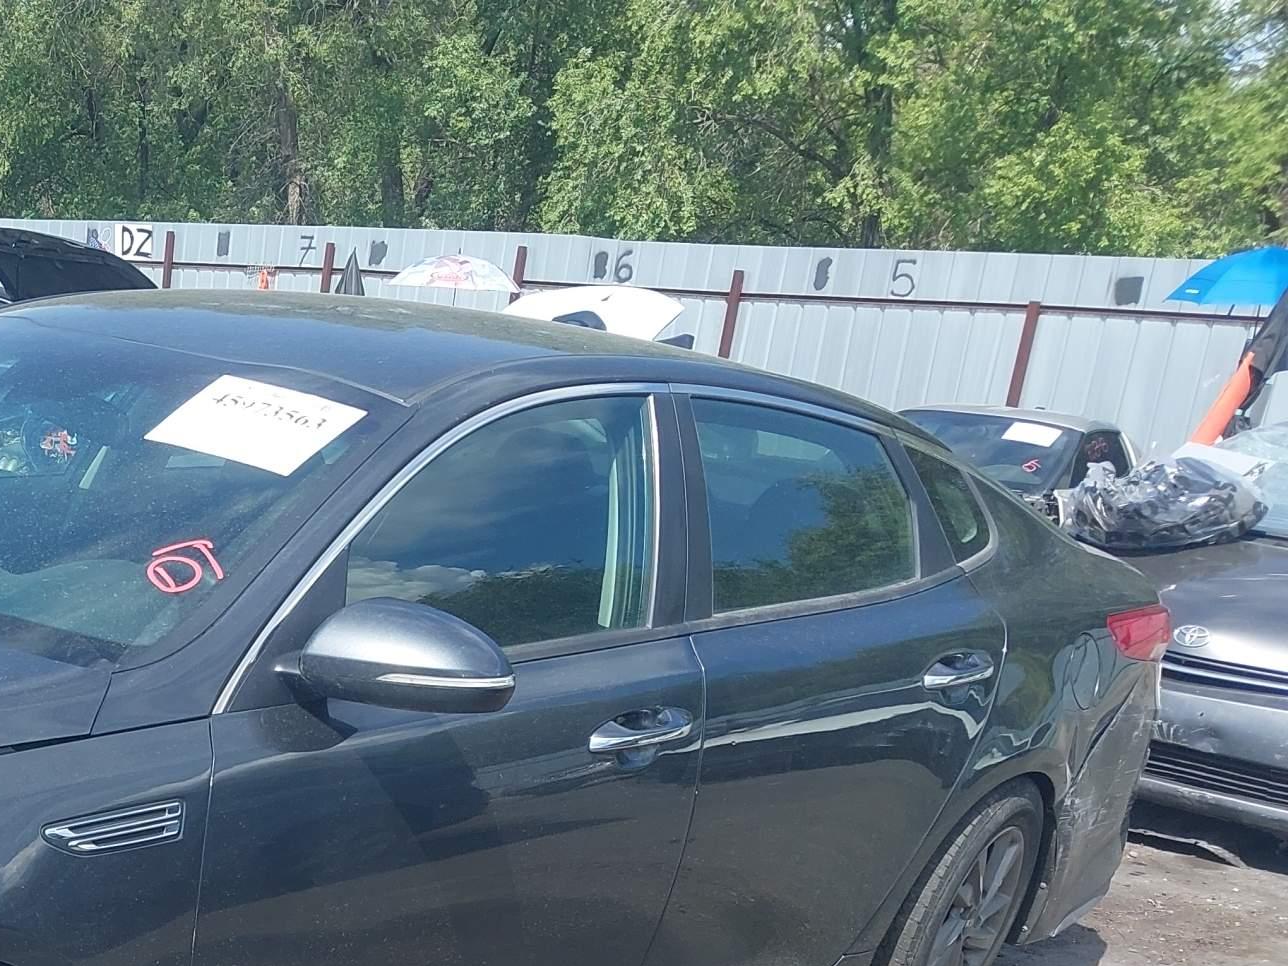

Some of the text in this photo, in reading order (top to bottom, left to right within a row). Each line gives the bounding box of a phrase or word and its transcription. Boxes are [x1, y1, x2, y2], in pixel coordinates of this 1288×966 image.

[121, 225, 152, 258] DZ
[299, 235, 317, 267] 7
[615, 249, 633, 283] 6
[890, 259, 917, 297] 5
